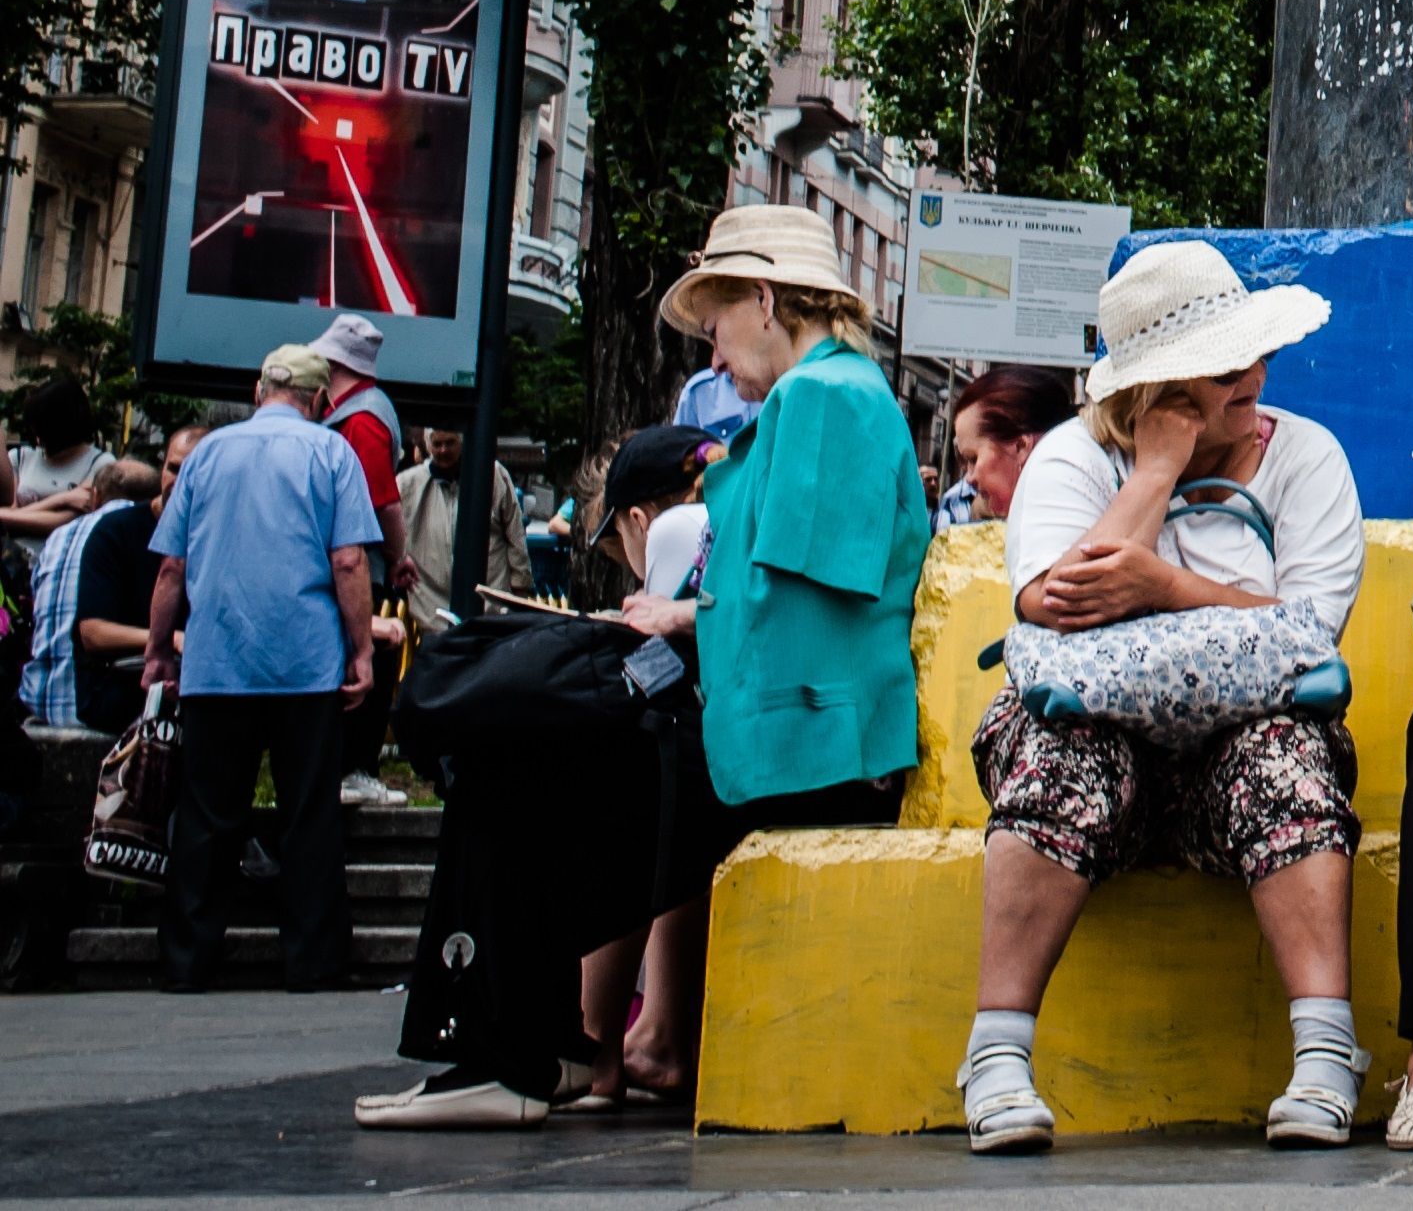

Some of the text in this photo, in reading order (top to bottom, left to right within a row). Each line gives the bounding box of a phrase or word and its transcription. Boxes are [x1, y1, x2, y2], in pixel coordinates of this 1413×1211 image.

[215, 15, 381, 82] Право
[958, 216, 1003, 228] БУЛЬВАР
[1025, 221, 1083, 234] ШЕВЧЕНКА
